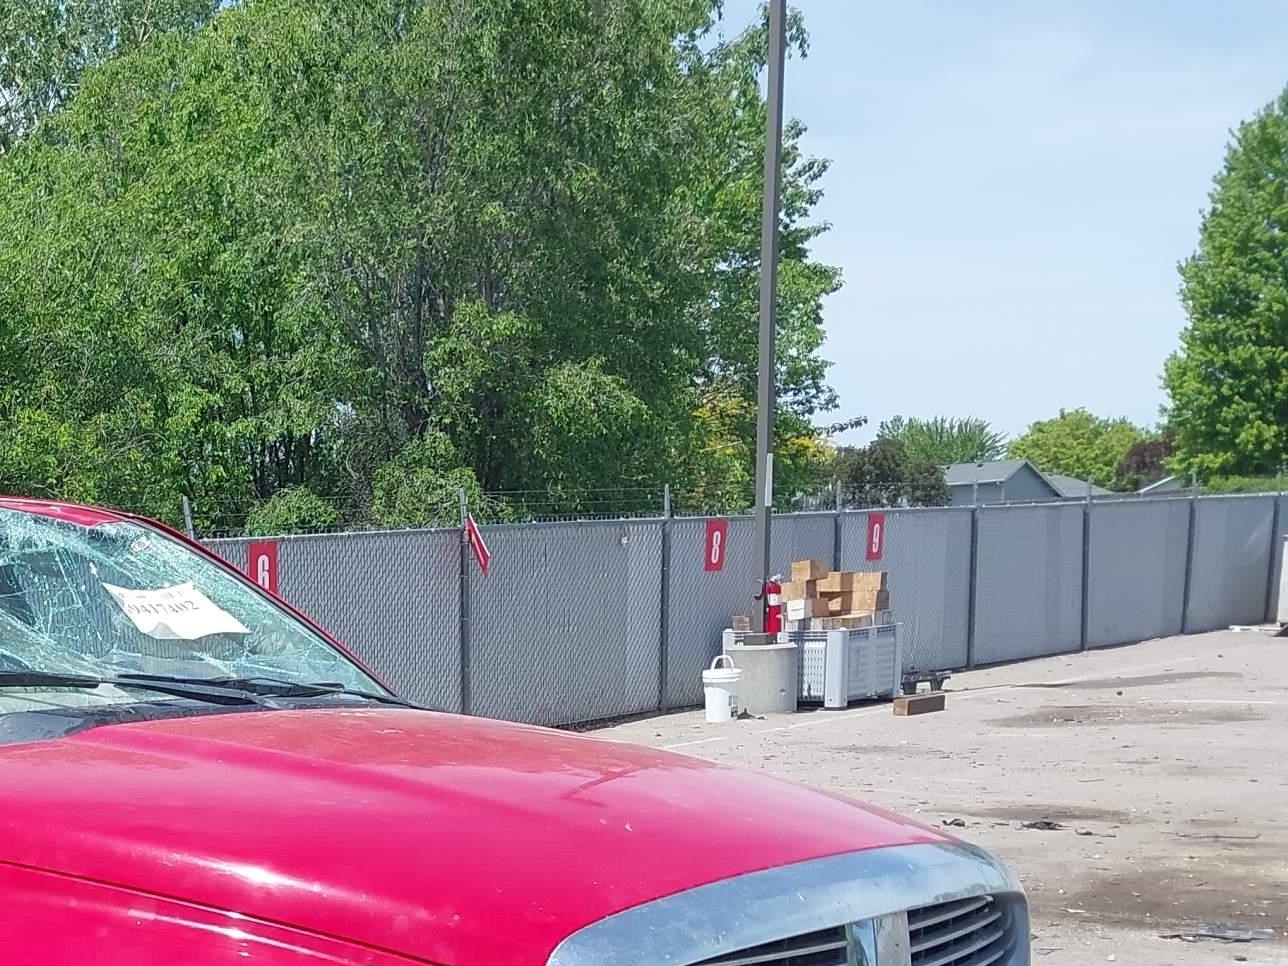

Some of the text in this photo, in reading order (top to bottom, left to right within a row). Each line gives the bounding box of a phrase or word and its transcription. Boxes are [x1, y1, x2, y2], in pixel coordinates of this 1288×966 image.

[711, 530, 721, 564] 8
[872, 523, 880, 553] 9
[257, 554, 270, 589] 6
